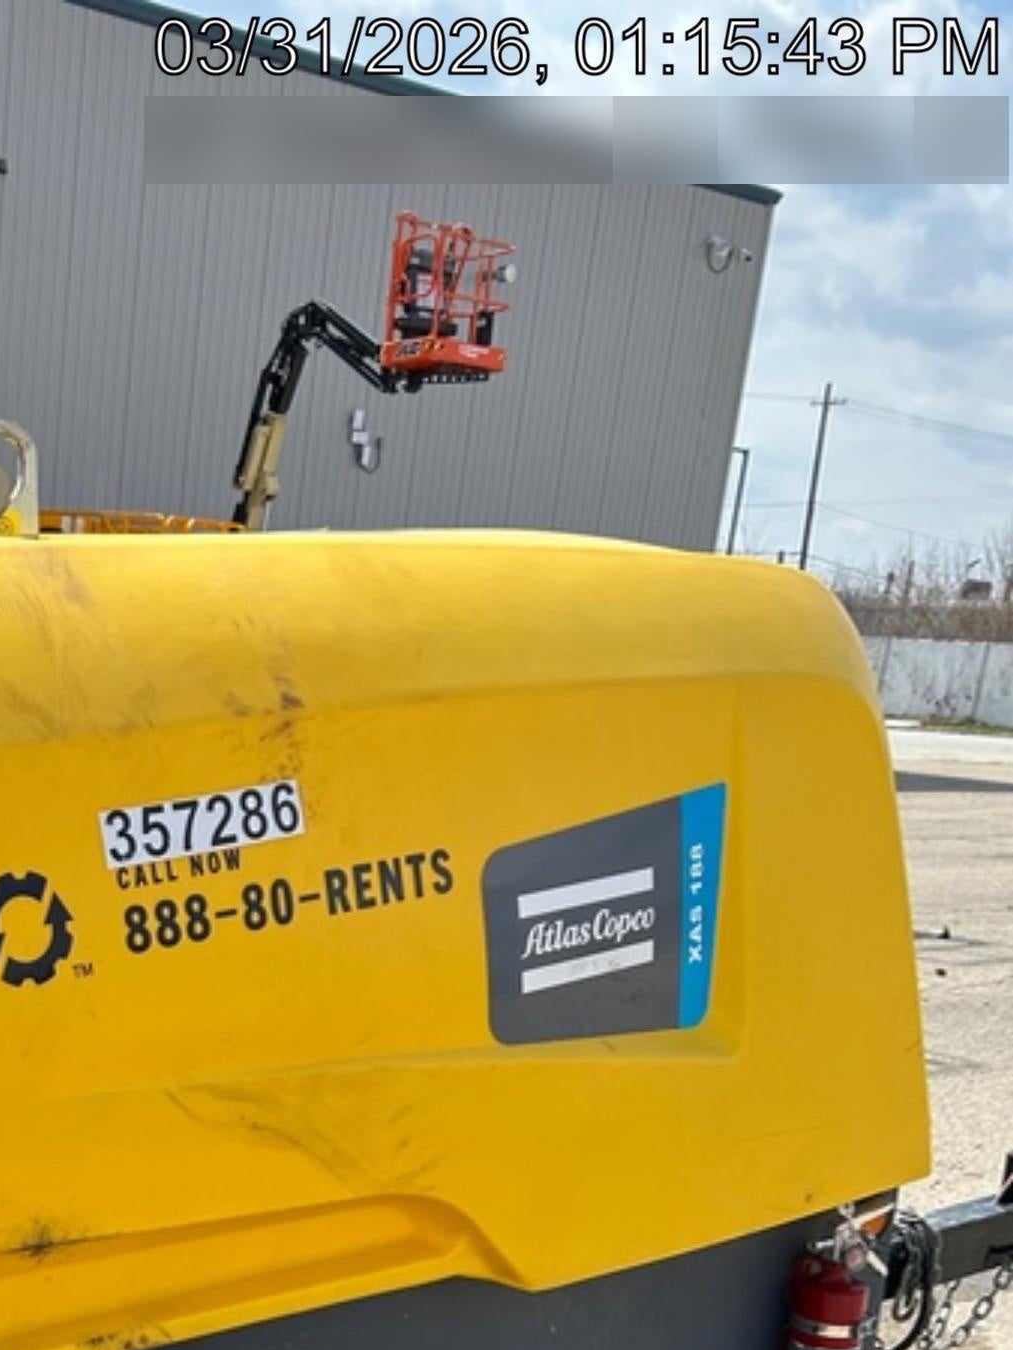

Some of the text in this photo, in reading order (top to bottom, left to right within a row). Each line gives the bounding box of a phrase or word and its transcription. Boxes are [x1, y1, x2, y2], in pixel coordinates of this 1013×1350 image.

[105, 782, 300, 863] 357286
[117, 848, 242, 889] CALL NOW
[124, 848, 454, 954] 888-80-RENTS
